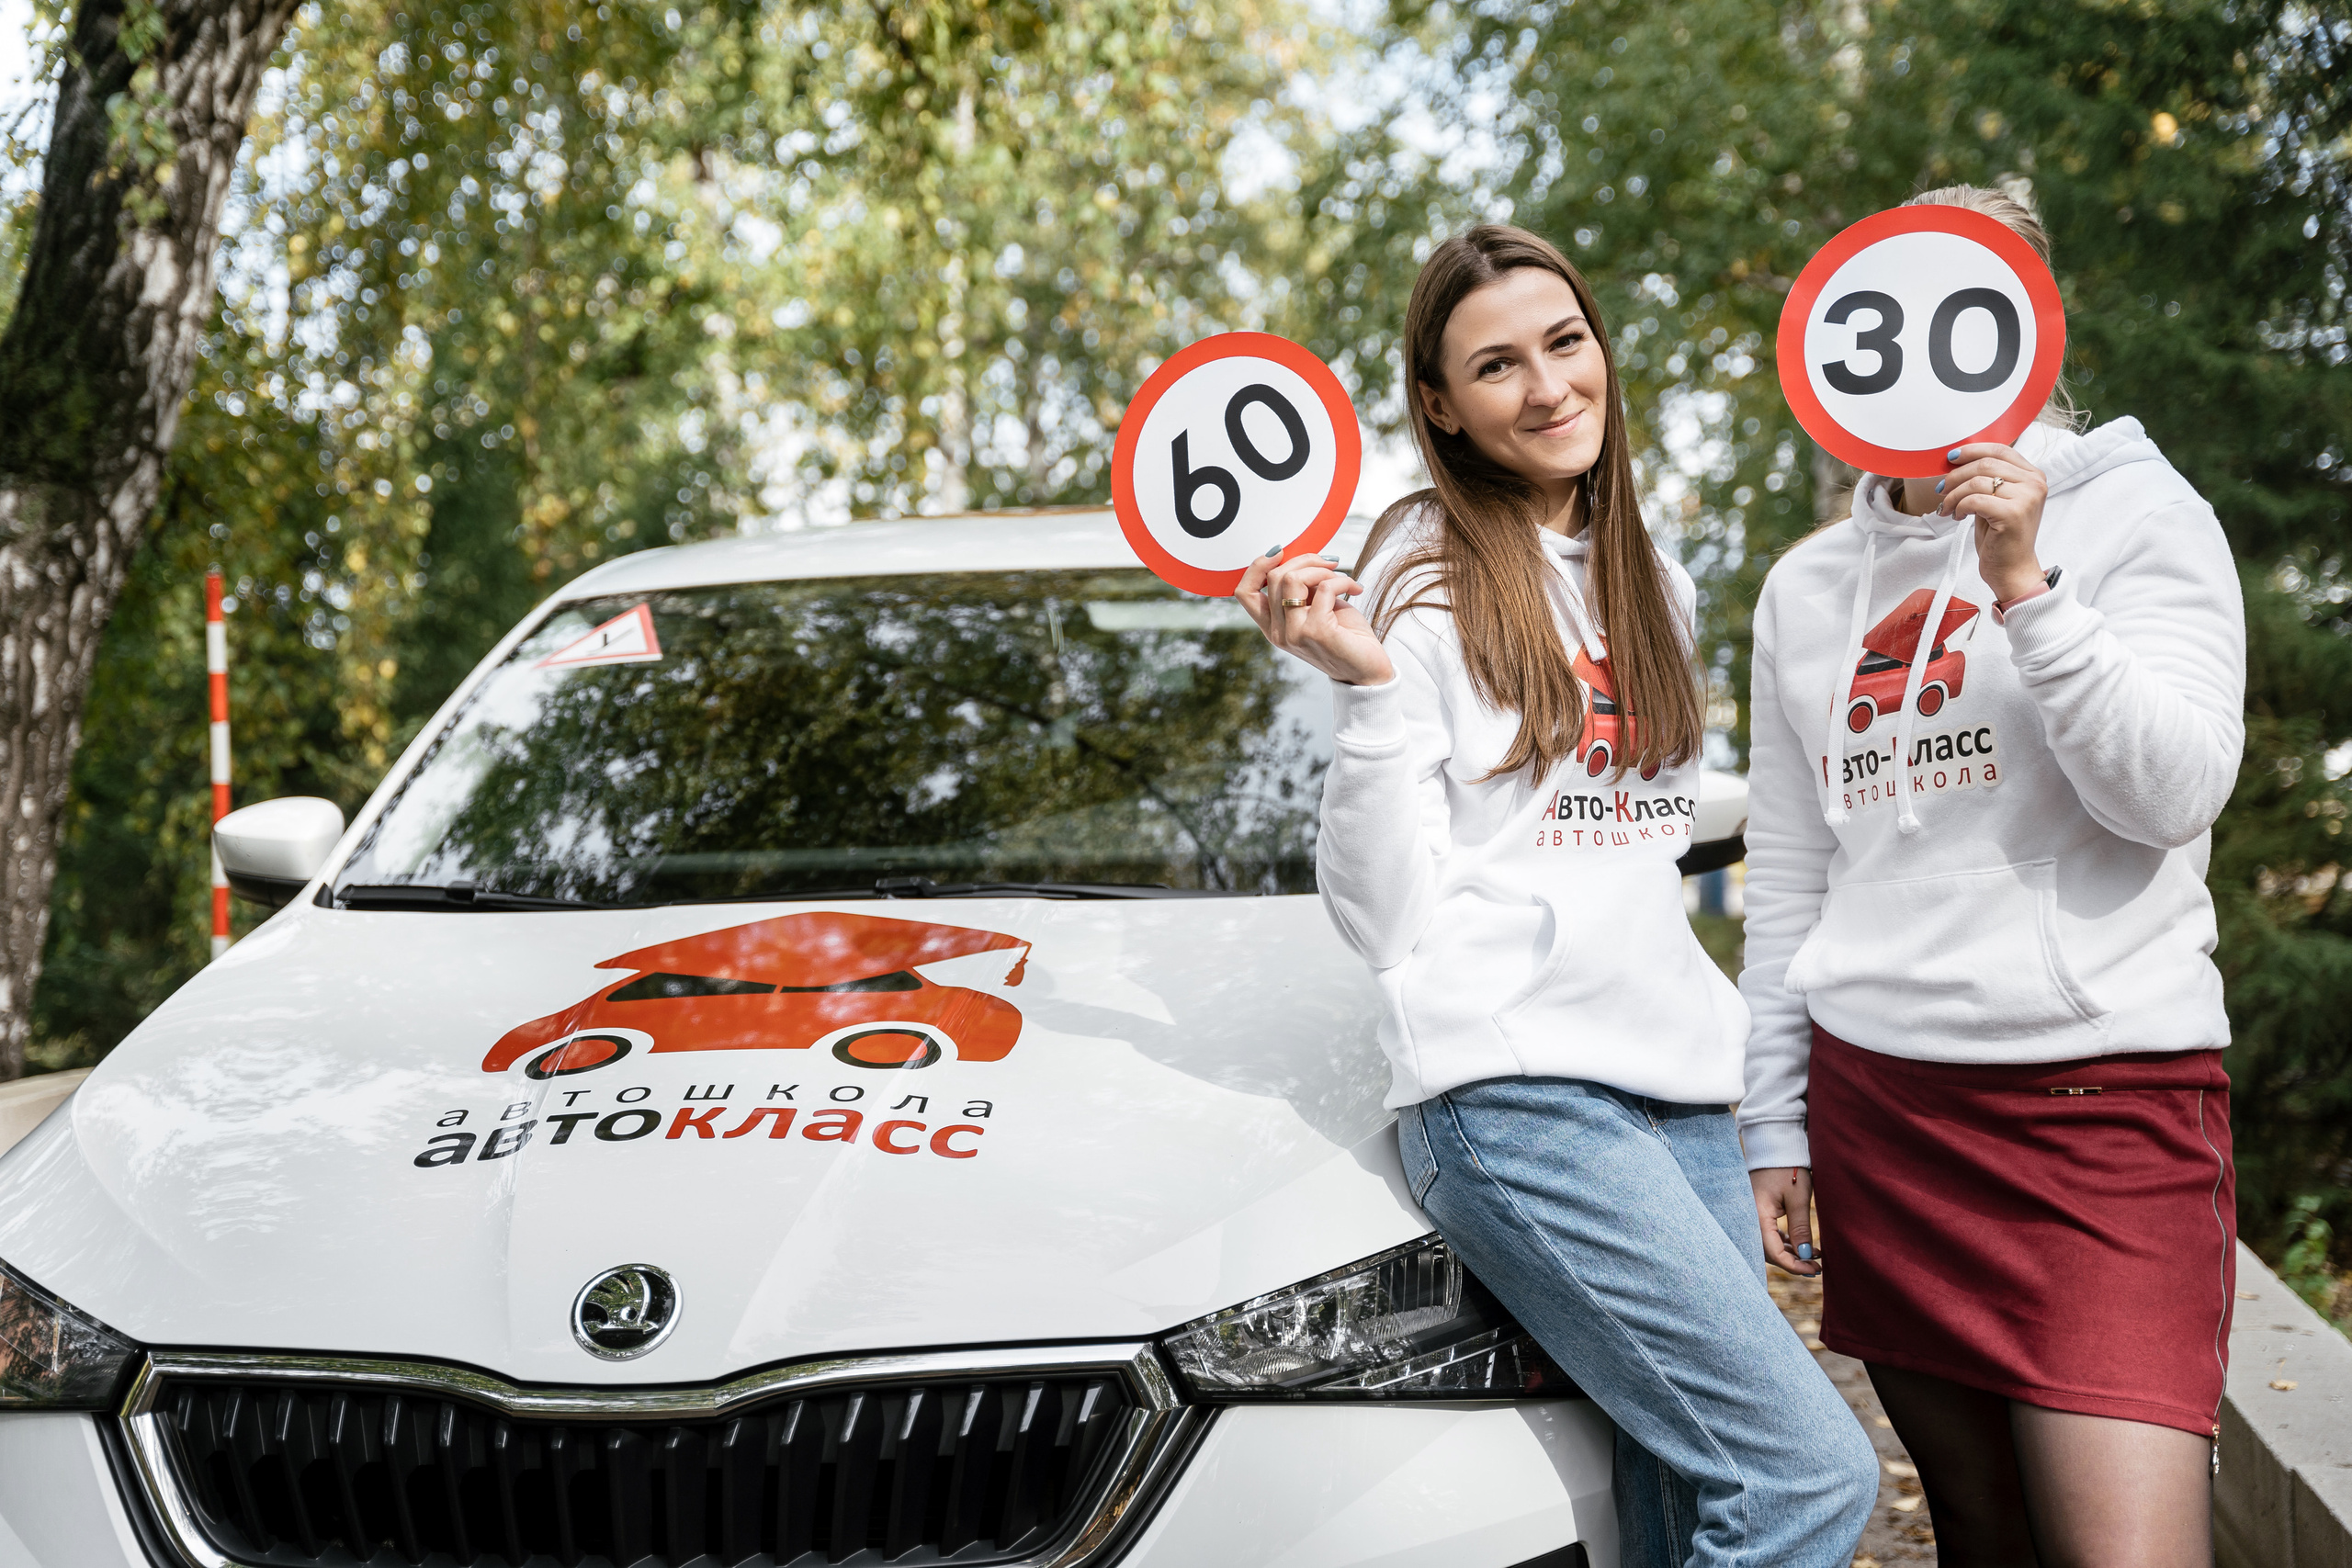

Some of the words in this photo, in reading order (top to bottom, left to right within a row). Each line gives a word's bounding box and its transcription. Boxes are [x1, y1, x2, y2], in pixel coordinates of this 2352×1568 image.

[1822, 287, 2021, 395] 30
[1171, 383, 1311, 539] 60
[1843, 762, 1997, 809] втошкола
[1536, 823, 1691, 847] автошкол
[435, 1084, 993, 1127] автошкола
[413, 1106, 985, 1168] автокласс
